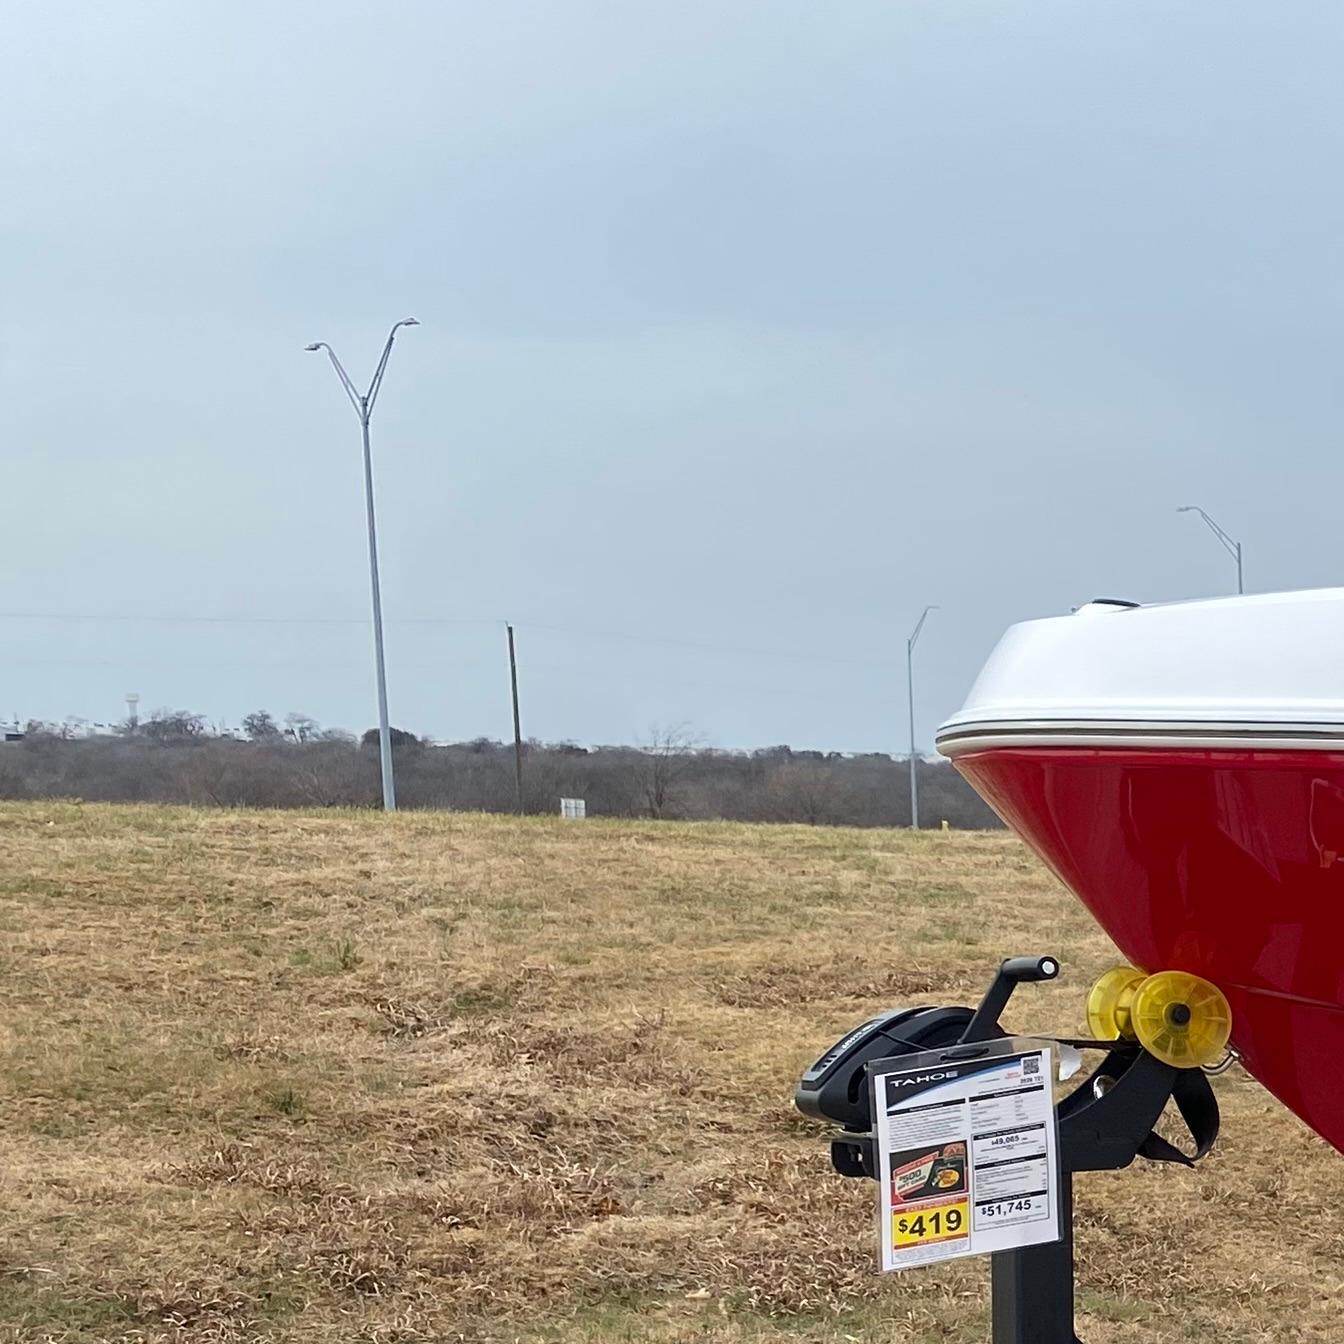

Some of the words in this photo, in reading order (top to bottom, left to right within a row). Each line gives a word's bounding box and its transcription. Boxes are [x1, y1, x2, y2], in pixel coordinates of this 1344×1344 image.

[889, 1070, 958, 1088] TAHOE
[981, 1200, 1032, 1217] $51,745
[898, 1209, 962, 1237] $419
